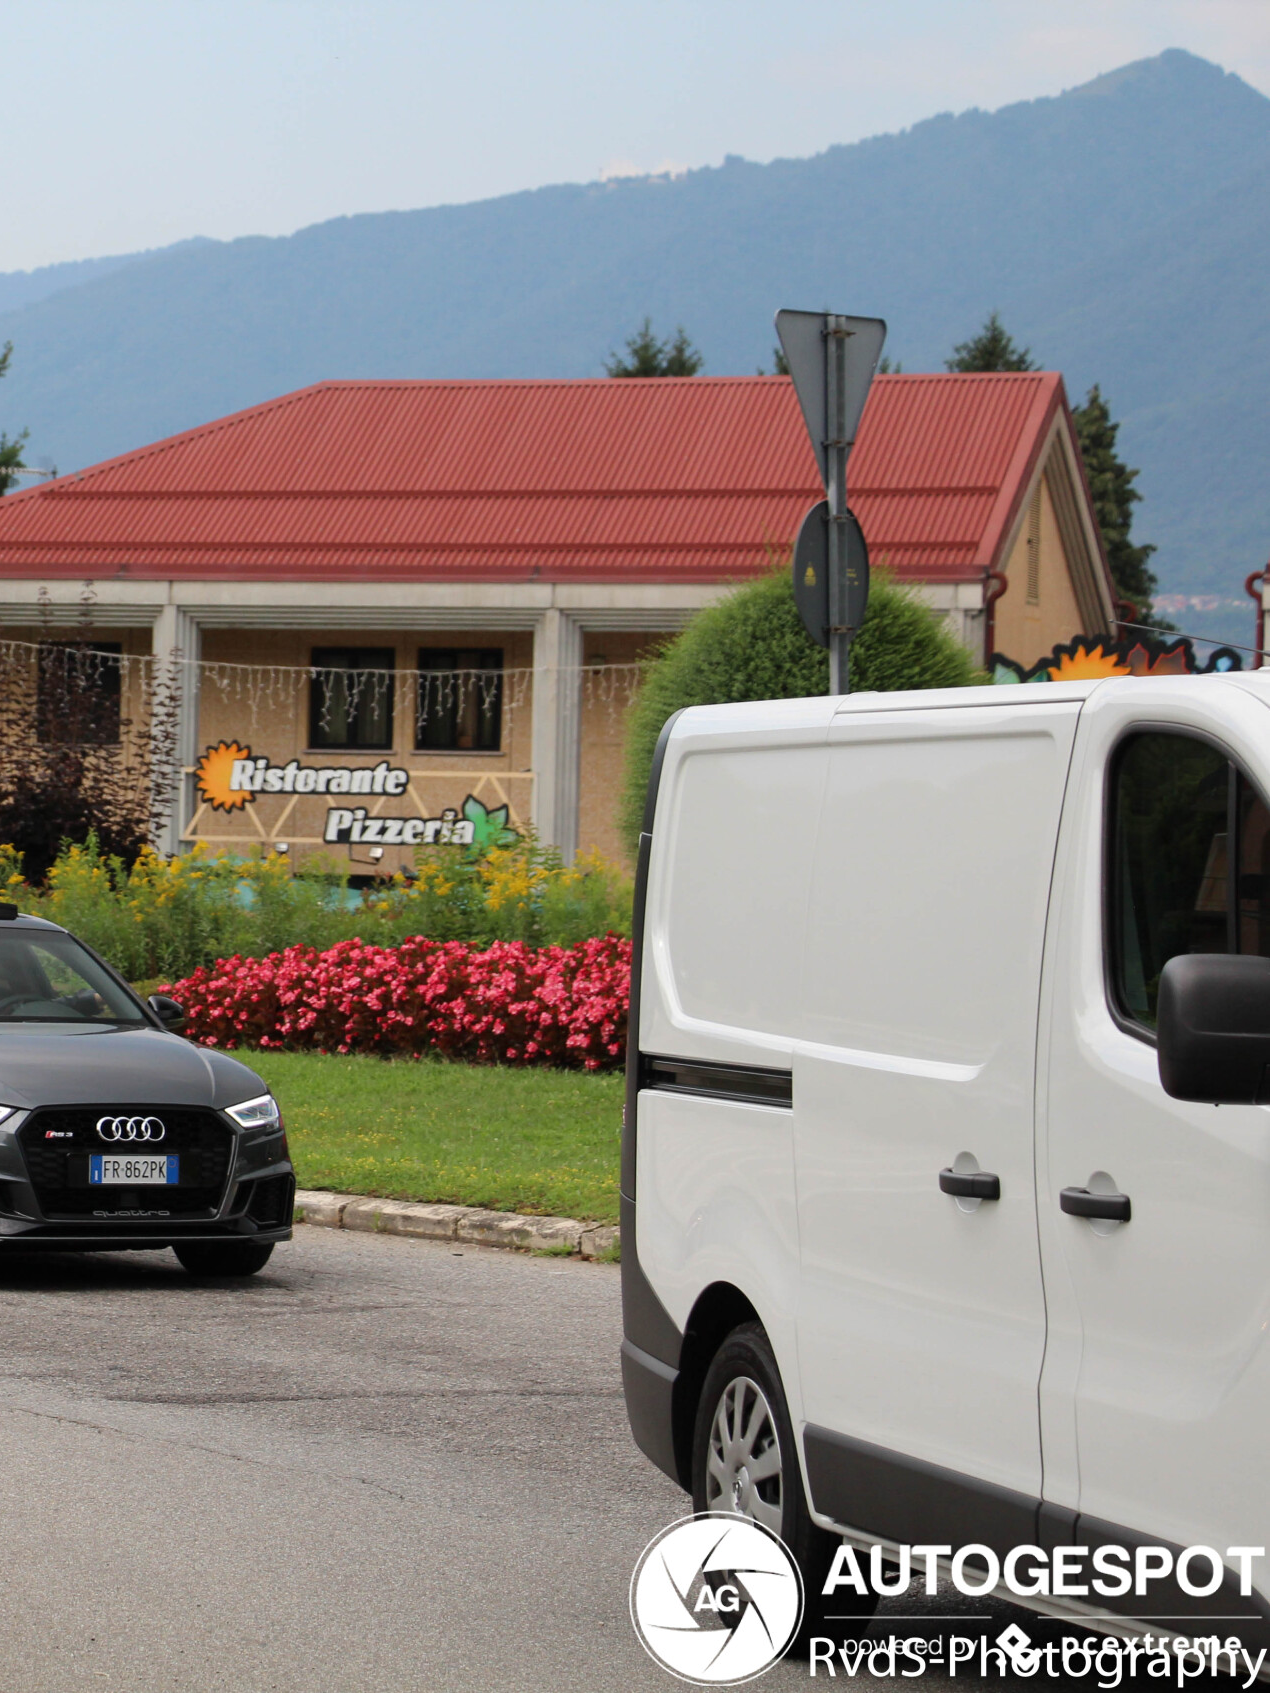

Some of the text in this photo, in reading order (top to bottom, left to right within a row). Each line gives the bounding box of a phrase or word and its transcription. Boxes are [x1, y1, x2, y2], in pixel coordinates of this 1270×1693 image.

[230, 758, 408, 795] Ristorante
[324, 808, 474, 845] Pizzeria
[92, 1210, 170, 1218] quattro
